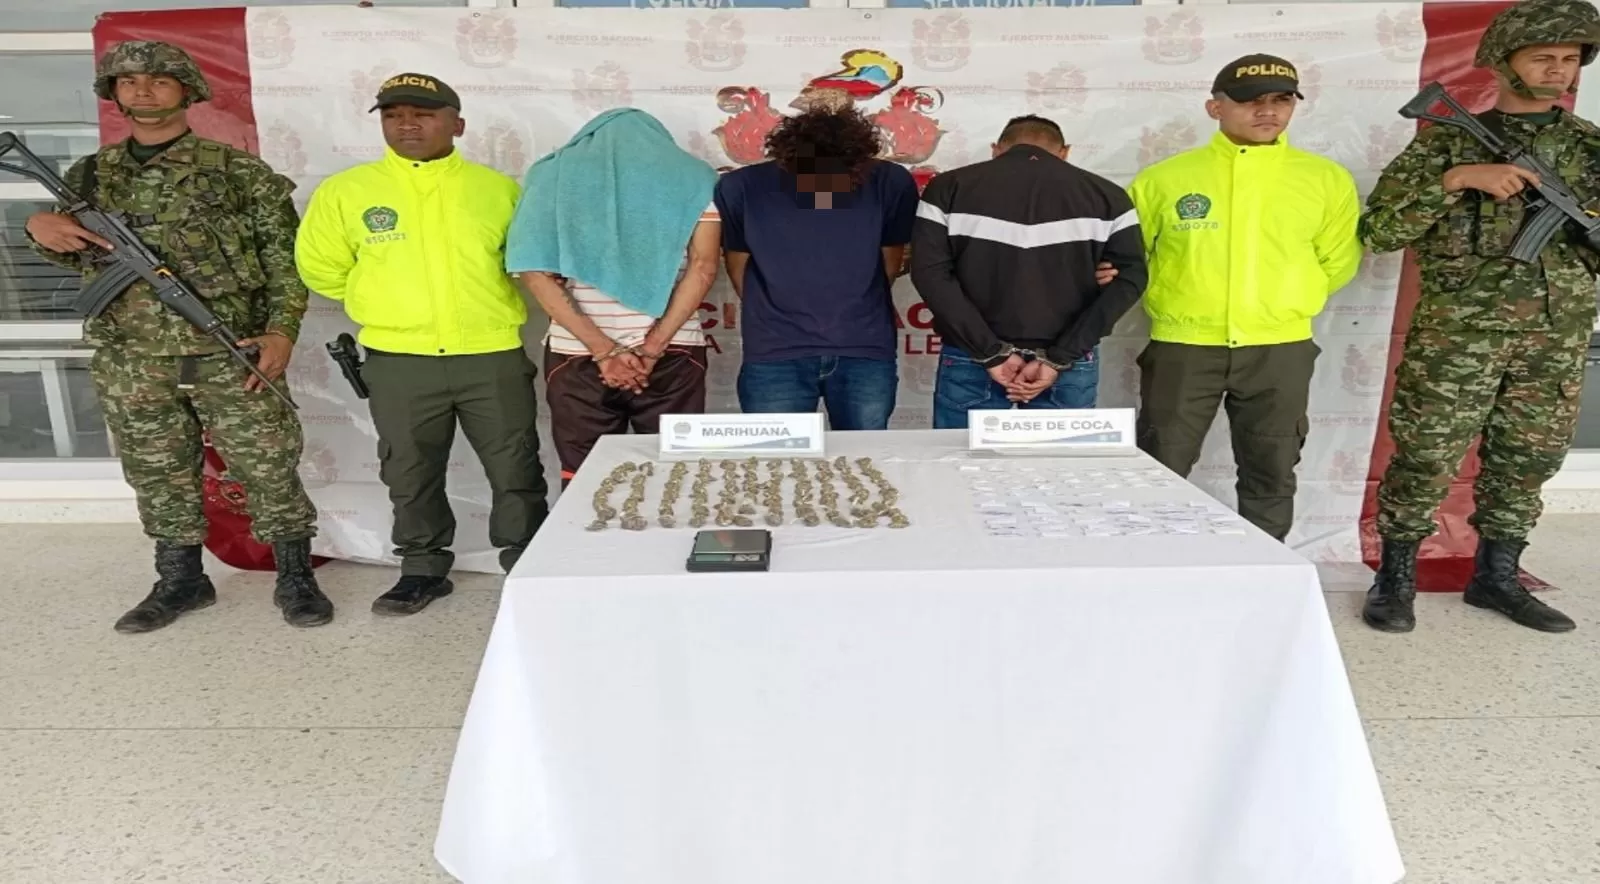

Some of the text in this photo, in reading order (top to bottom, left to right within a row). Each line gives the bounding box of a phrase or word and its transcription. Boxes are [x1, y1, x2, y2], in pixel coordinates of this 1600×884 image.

[1235, 63, 1296, 80] POLICIA
[1001, 420, 1043, 431] BASE
[1046, 420, 1067, 430] DE
[1070, 420, 1114, 430] COCA
[701, 426, 792, 438] MARIHUANA
